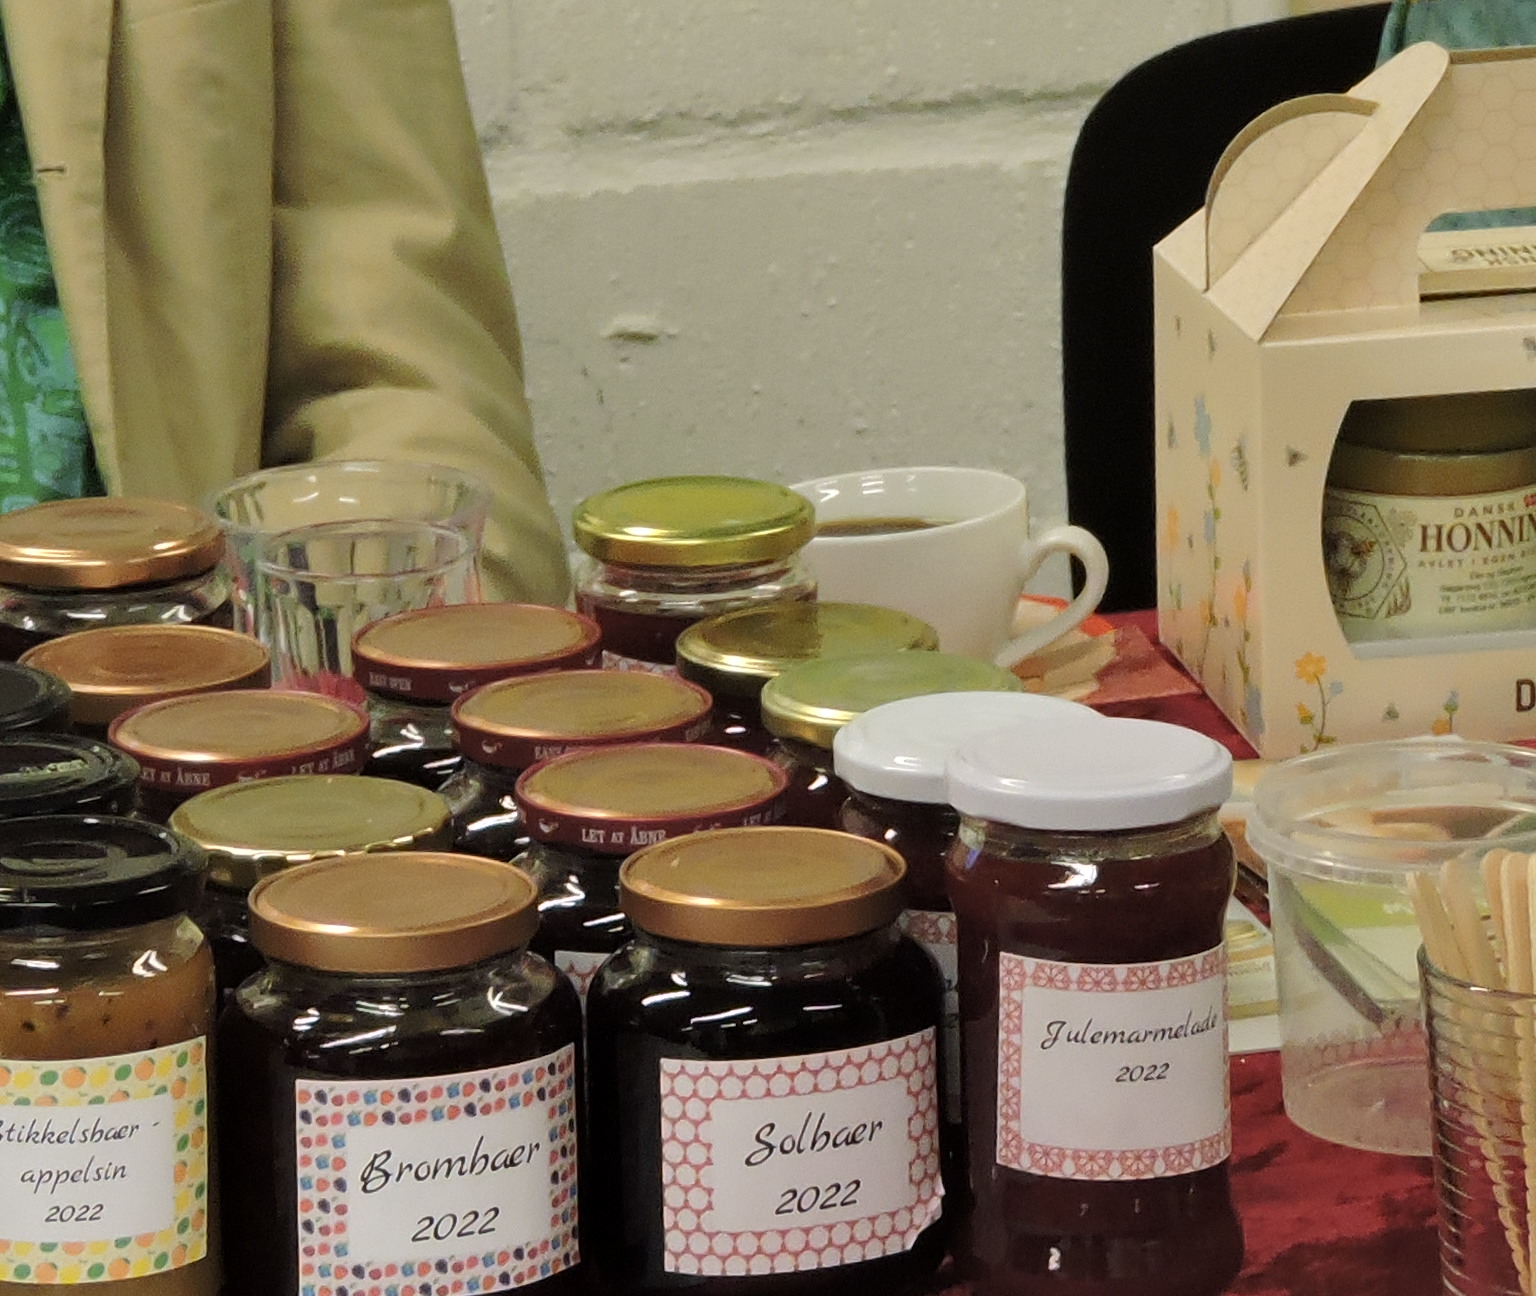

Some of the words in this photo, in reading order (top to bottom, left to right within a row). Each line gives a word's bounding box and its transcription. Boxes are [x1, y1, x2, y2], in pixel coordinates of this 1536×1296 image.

[175, 766, 212, 786] ÅBNE
[581, 827, 605, 843] LET
[610, 831, 625, 843] AT
[630, 824, 666, 845] ÅBNE
[1039, 1005, 1219, 1050] Julemarmelade
[1115, 1062, 1170, 1083] 2022
[19, 1155, 128, 1195] appelsin
[774, 1179, 862, 1215] 2022
[44, 1203, 105, 1224] 2022
[410, 1206, 501, 1243] 2022
